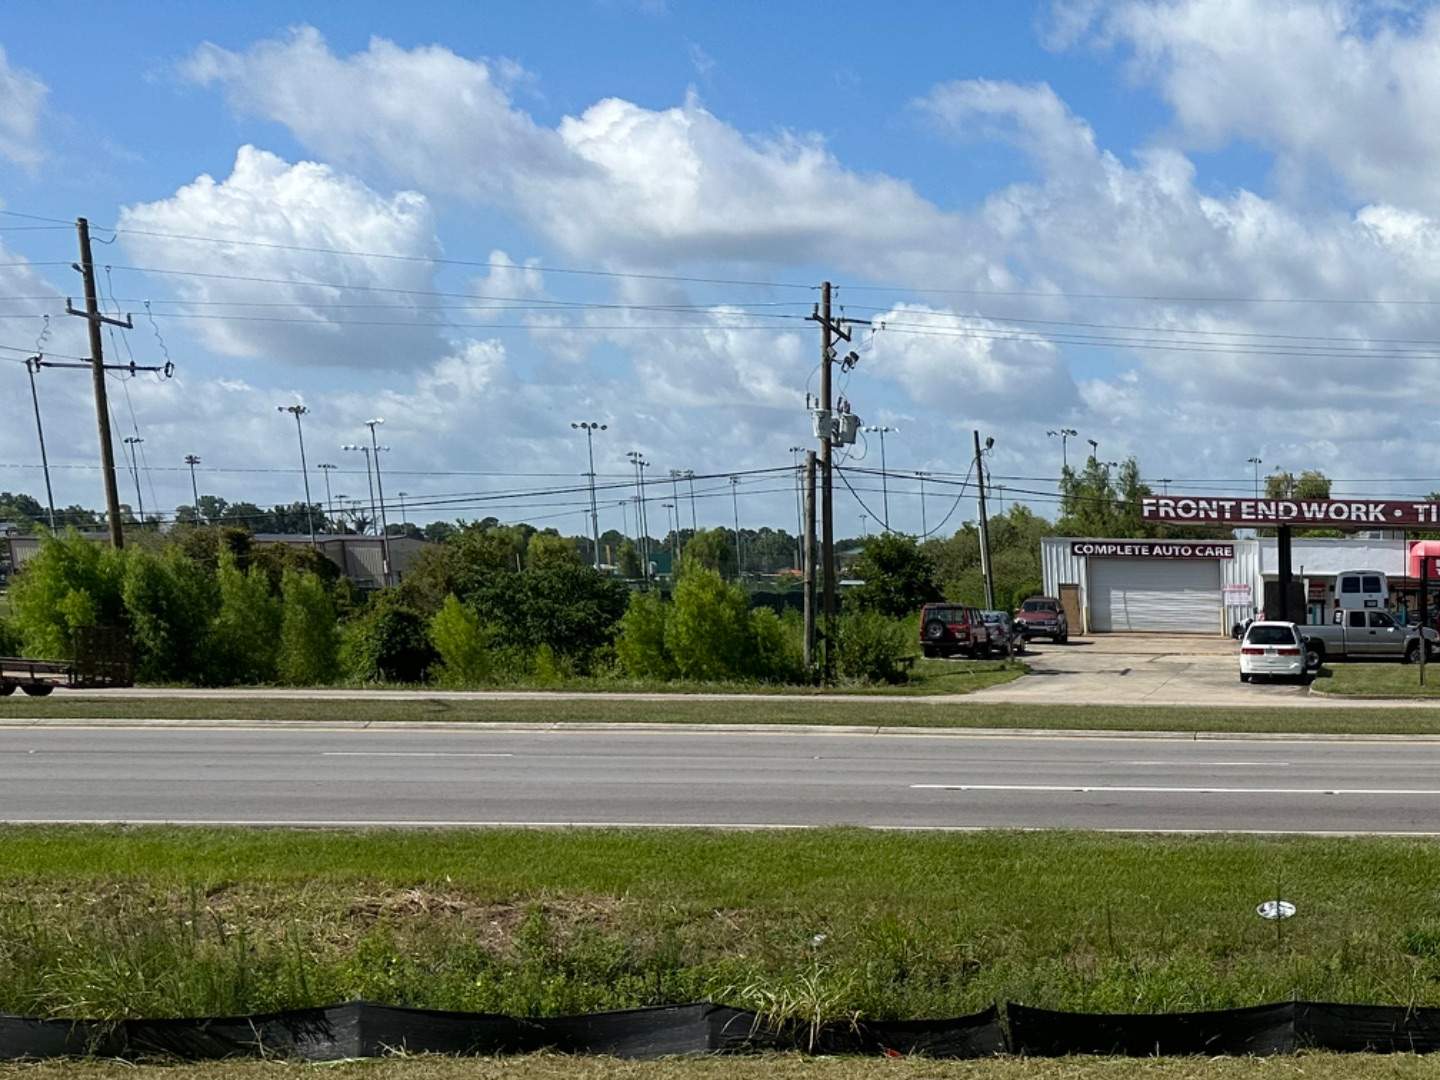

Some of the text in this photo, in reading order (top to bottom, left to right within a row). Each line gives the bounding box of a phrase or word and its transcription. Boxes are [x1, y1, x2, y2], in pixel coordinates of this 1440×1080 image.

[1142, 499, 1236, 518] FRONT
[1241, 501, 1298, 520] END
[1300, 502, 1386, 522] WORK
[1073, 544, 1233, 557] COMPLETE AUTO CARE
